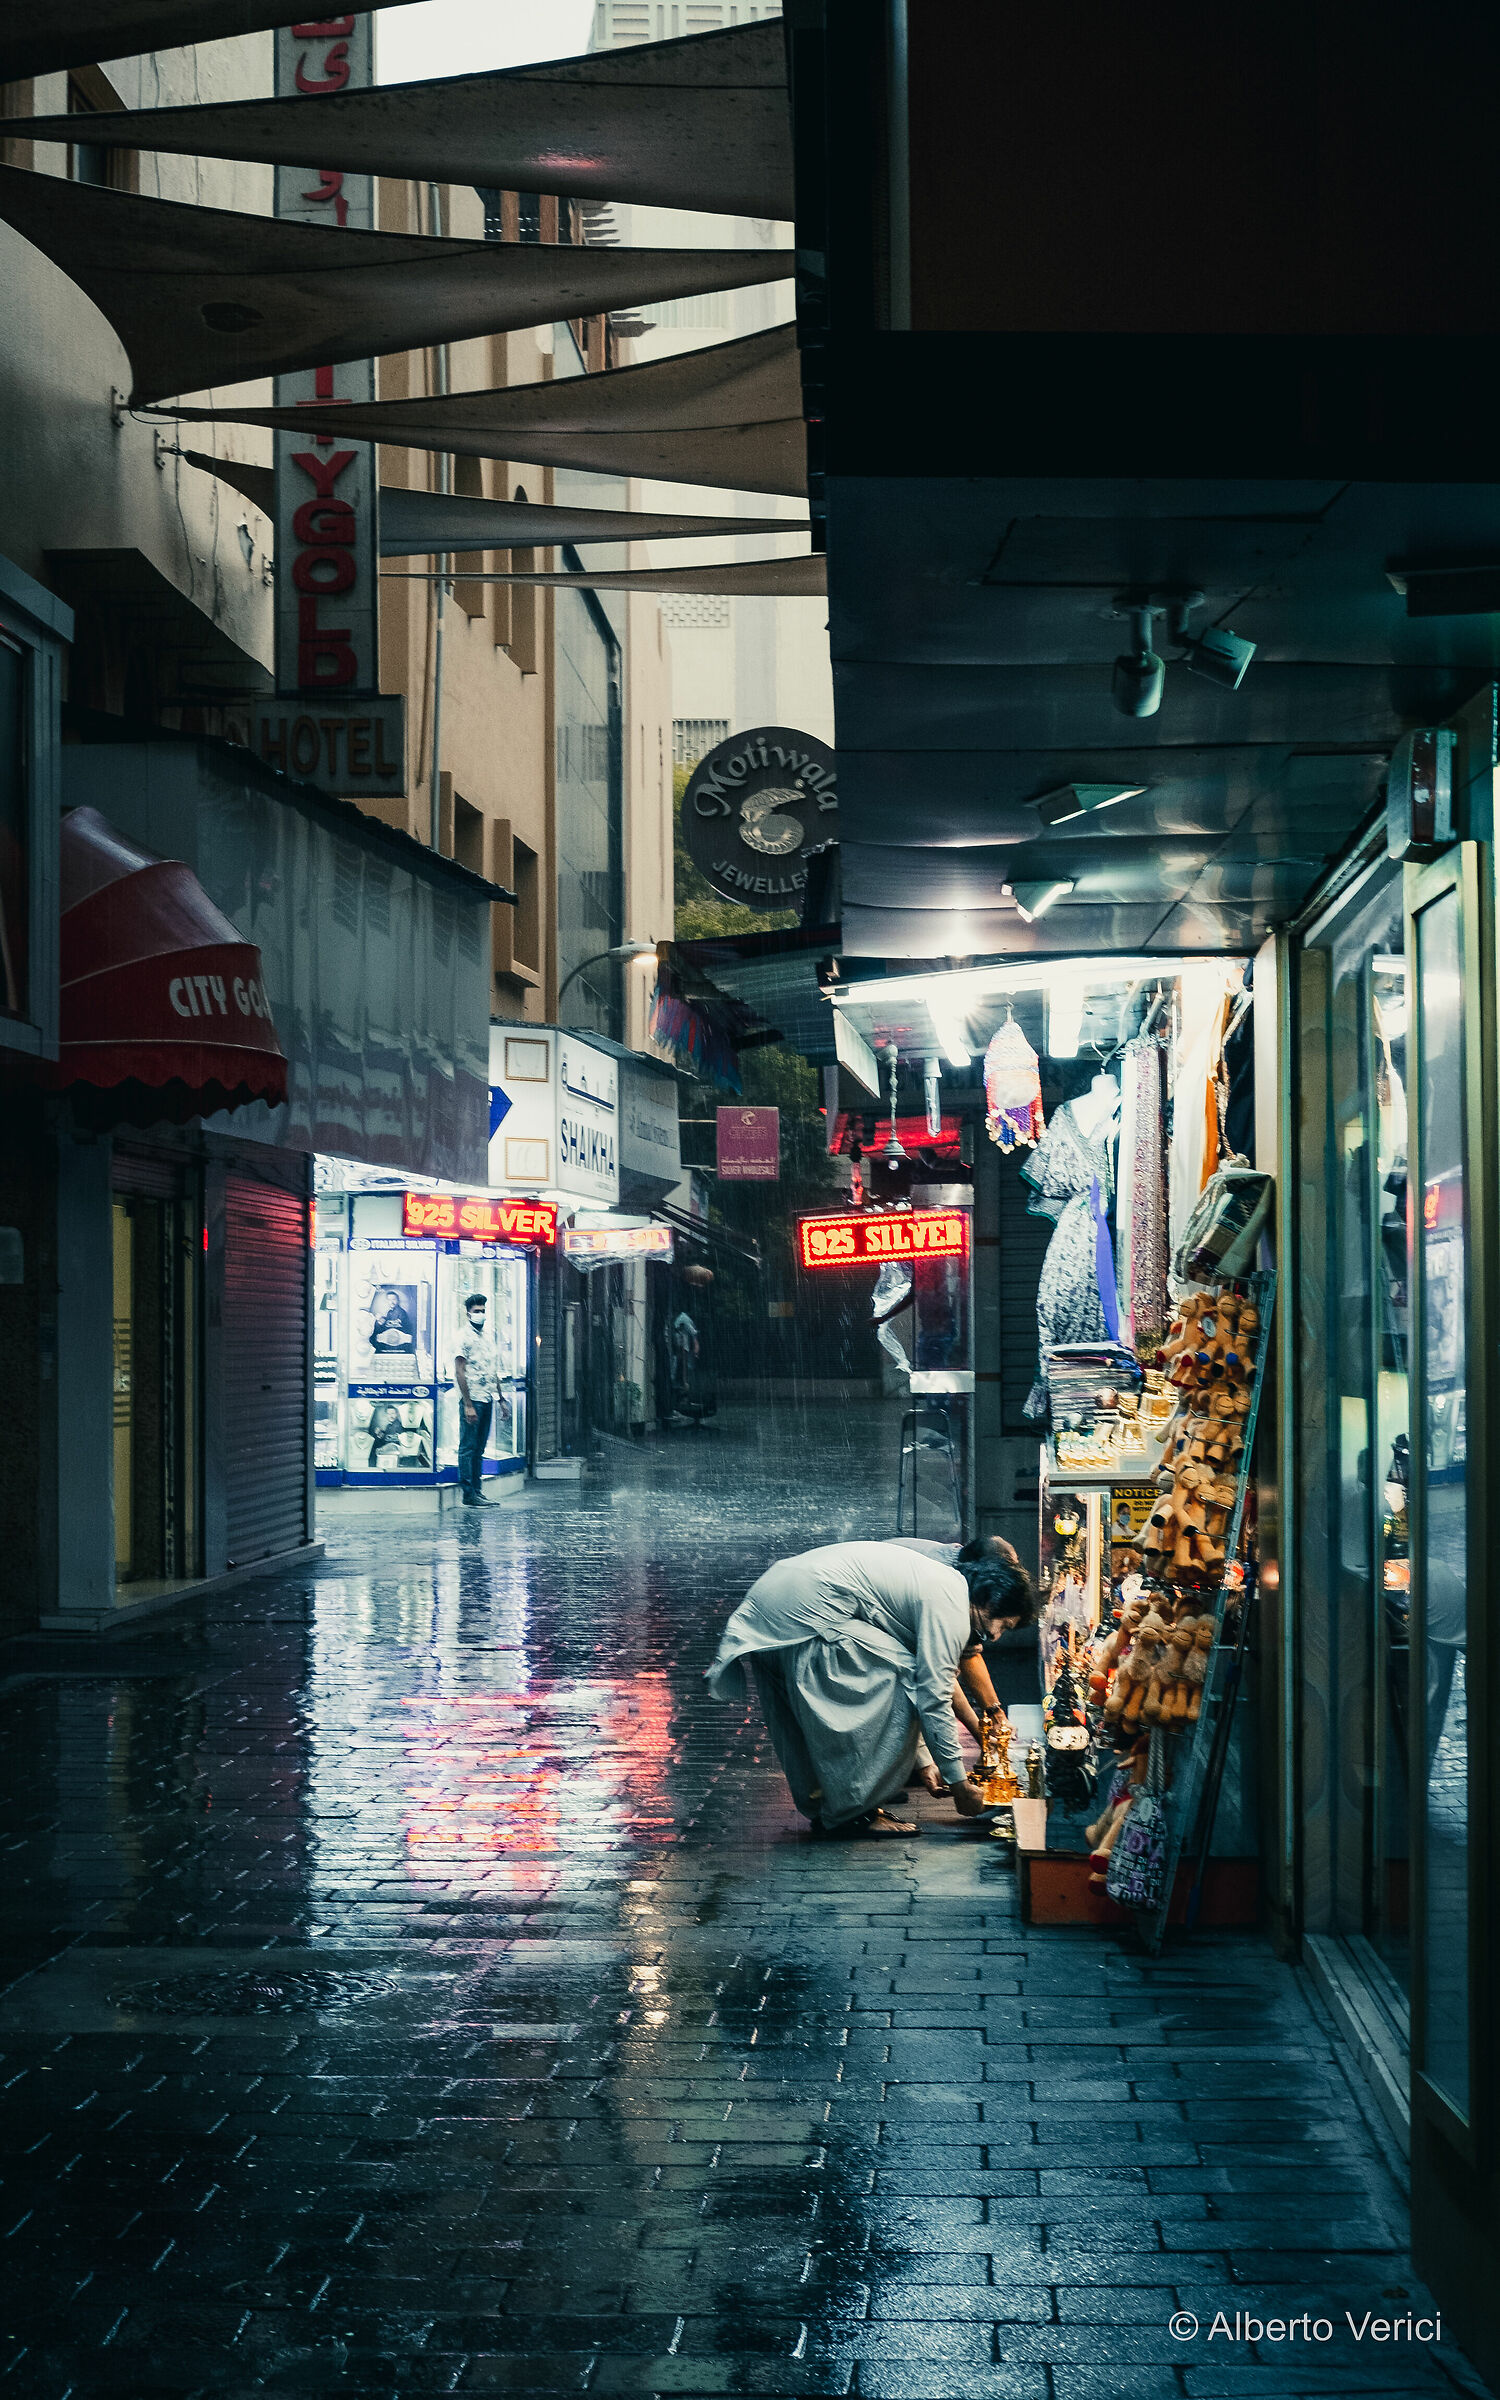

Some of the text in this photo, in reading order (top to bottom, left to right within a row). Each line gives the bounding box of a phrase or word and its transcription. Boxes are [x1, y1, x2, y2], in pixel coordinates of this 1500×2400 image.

[261, 715, 397, 776] HOTEL
[694, 737, 839, 818] Motiwala
[712, 860, 808, 894] JEWELLE
[169, 975, 272, 1019] CITY GO
[560, 1118, 616, 1178] SHAIKHA
[407, 1202, 553, 1233] 925 SILVER
[810, 1219, 962, 1256] 925 SILVER
[371, 1240, 404, 1249] ITALIAN
[405, 1241, 437, 1250] SILVER
